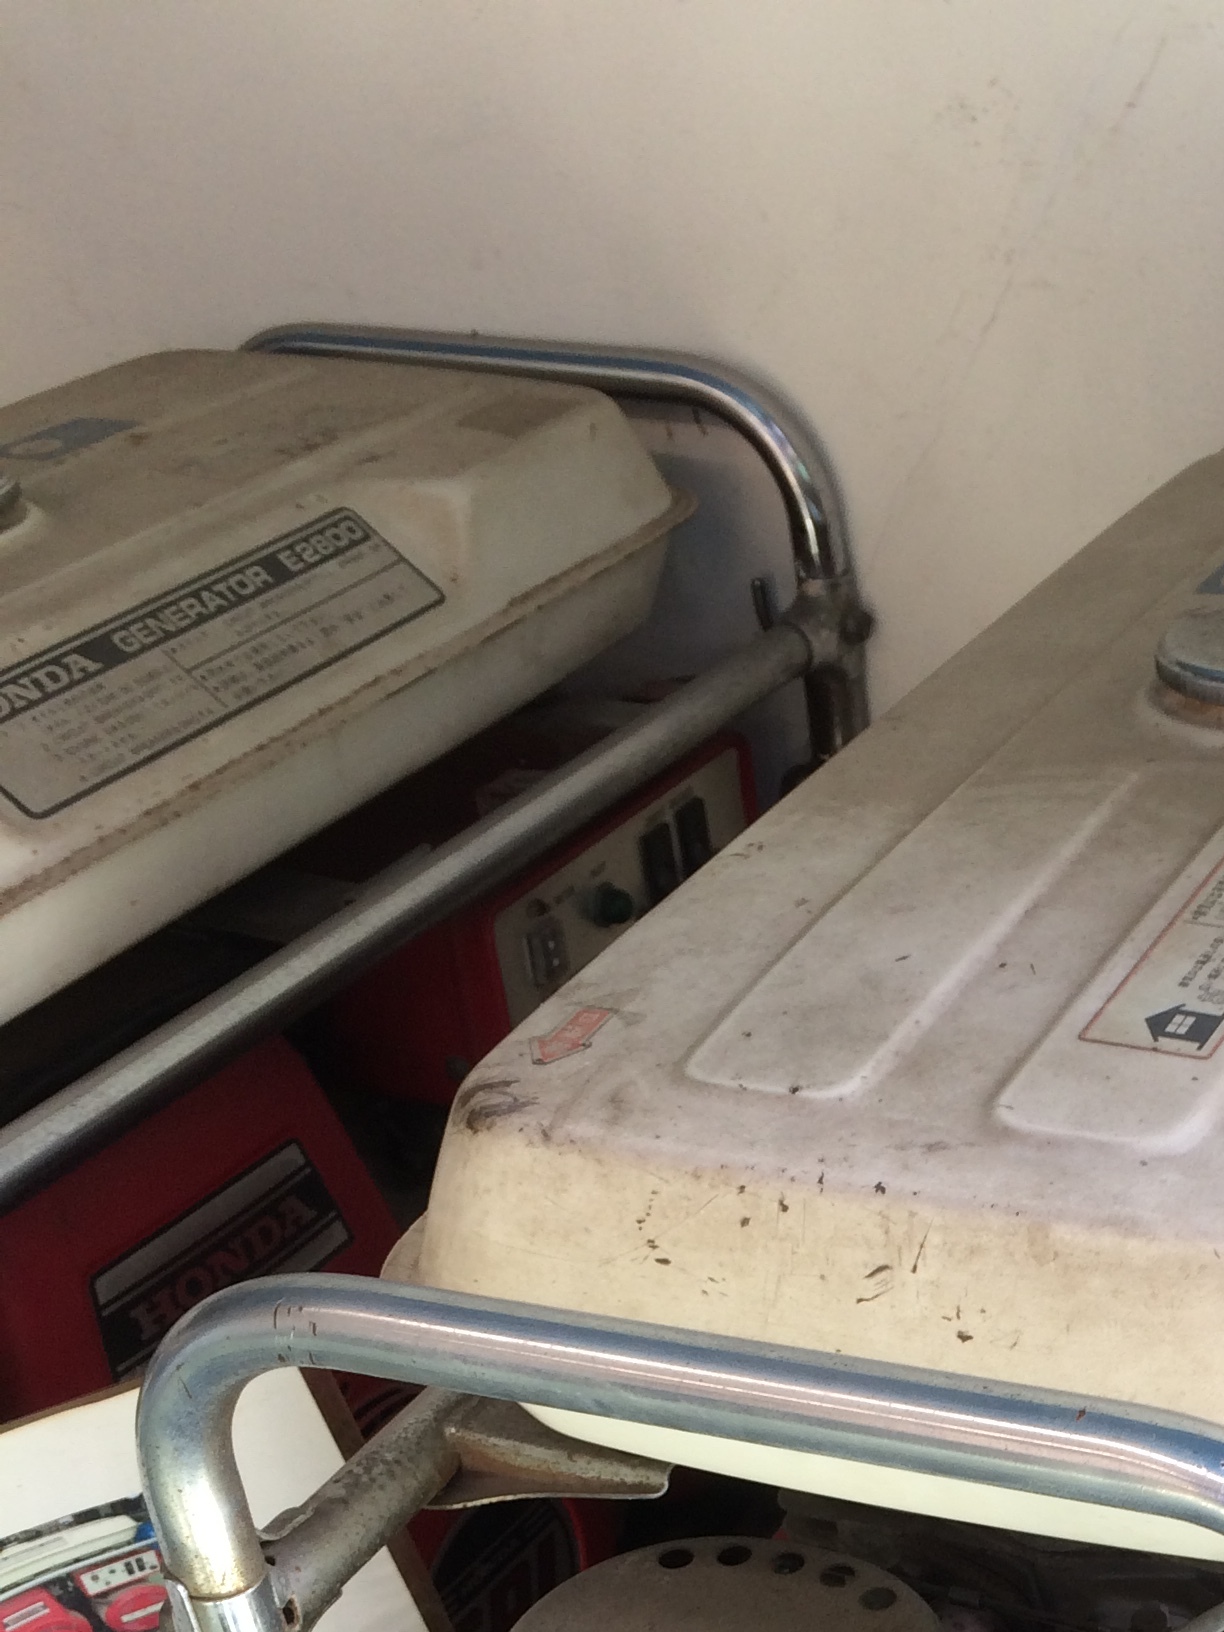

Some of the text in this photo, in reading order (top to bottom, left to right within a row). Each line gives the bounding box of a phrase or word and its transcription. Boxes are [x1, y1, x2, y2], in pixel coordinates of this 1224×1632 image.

[109, 564, 274, 654] GENERATOR
[275, 518, 365, 573] E2800
[129, 1196, 318, 1341] HONDA
